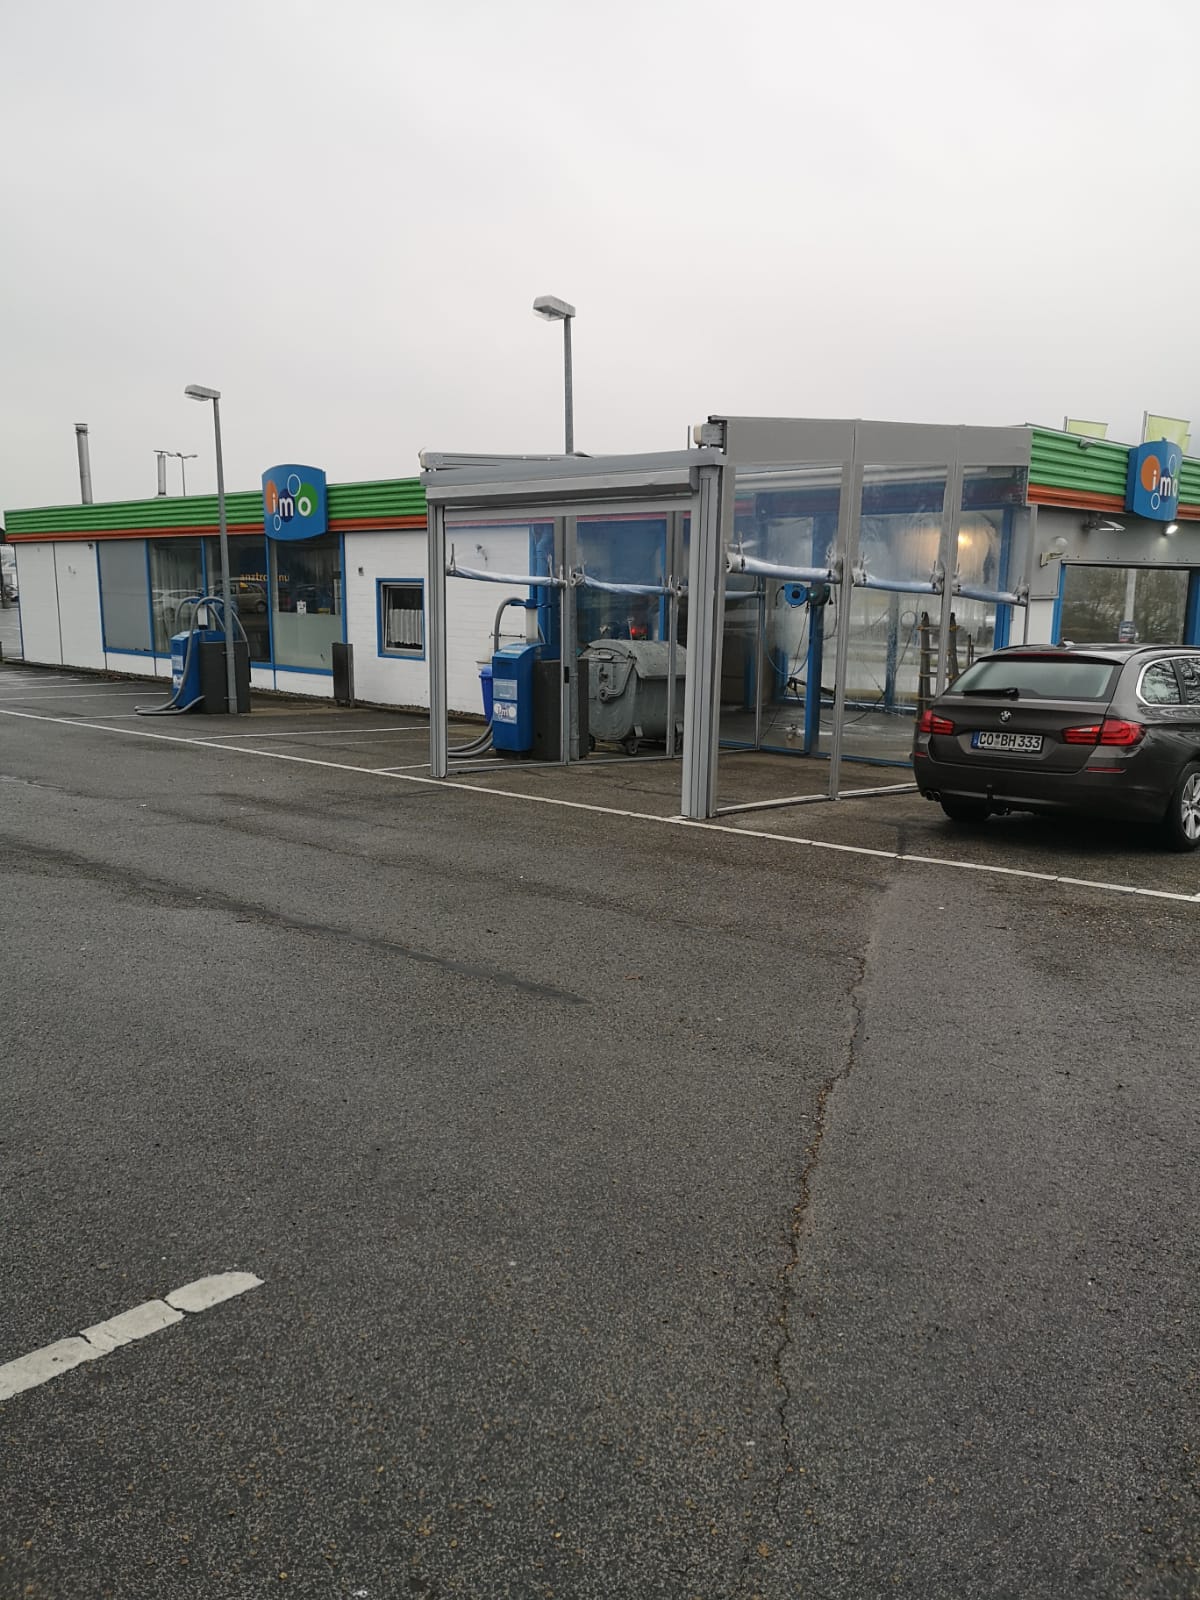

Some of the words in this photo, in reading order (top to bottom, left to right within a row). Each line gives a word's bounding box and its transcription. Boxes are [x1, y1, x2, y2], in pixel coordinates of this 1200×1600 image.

[1152, 469, 1178, 496] imo
[272, 492, 312, 517] imo
[980, 733, 994, 745] CO
[1001, 734, 1017, 747] BH
[1018, 735, 1041, 749] 333
